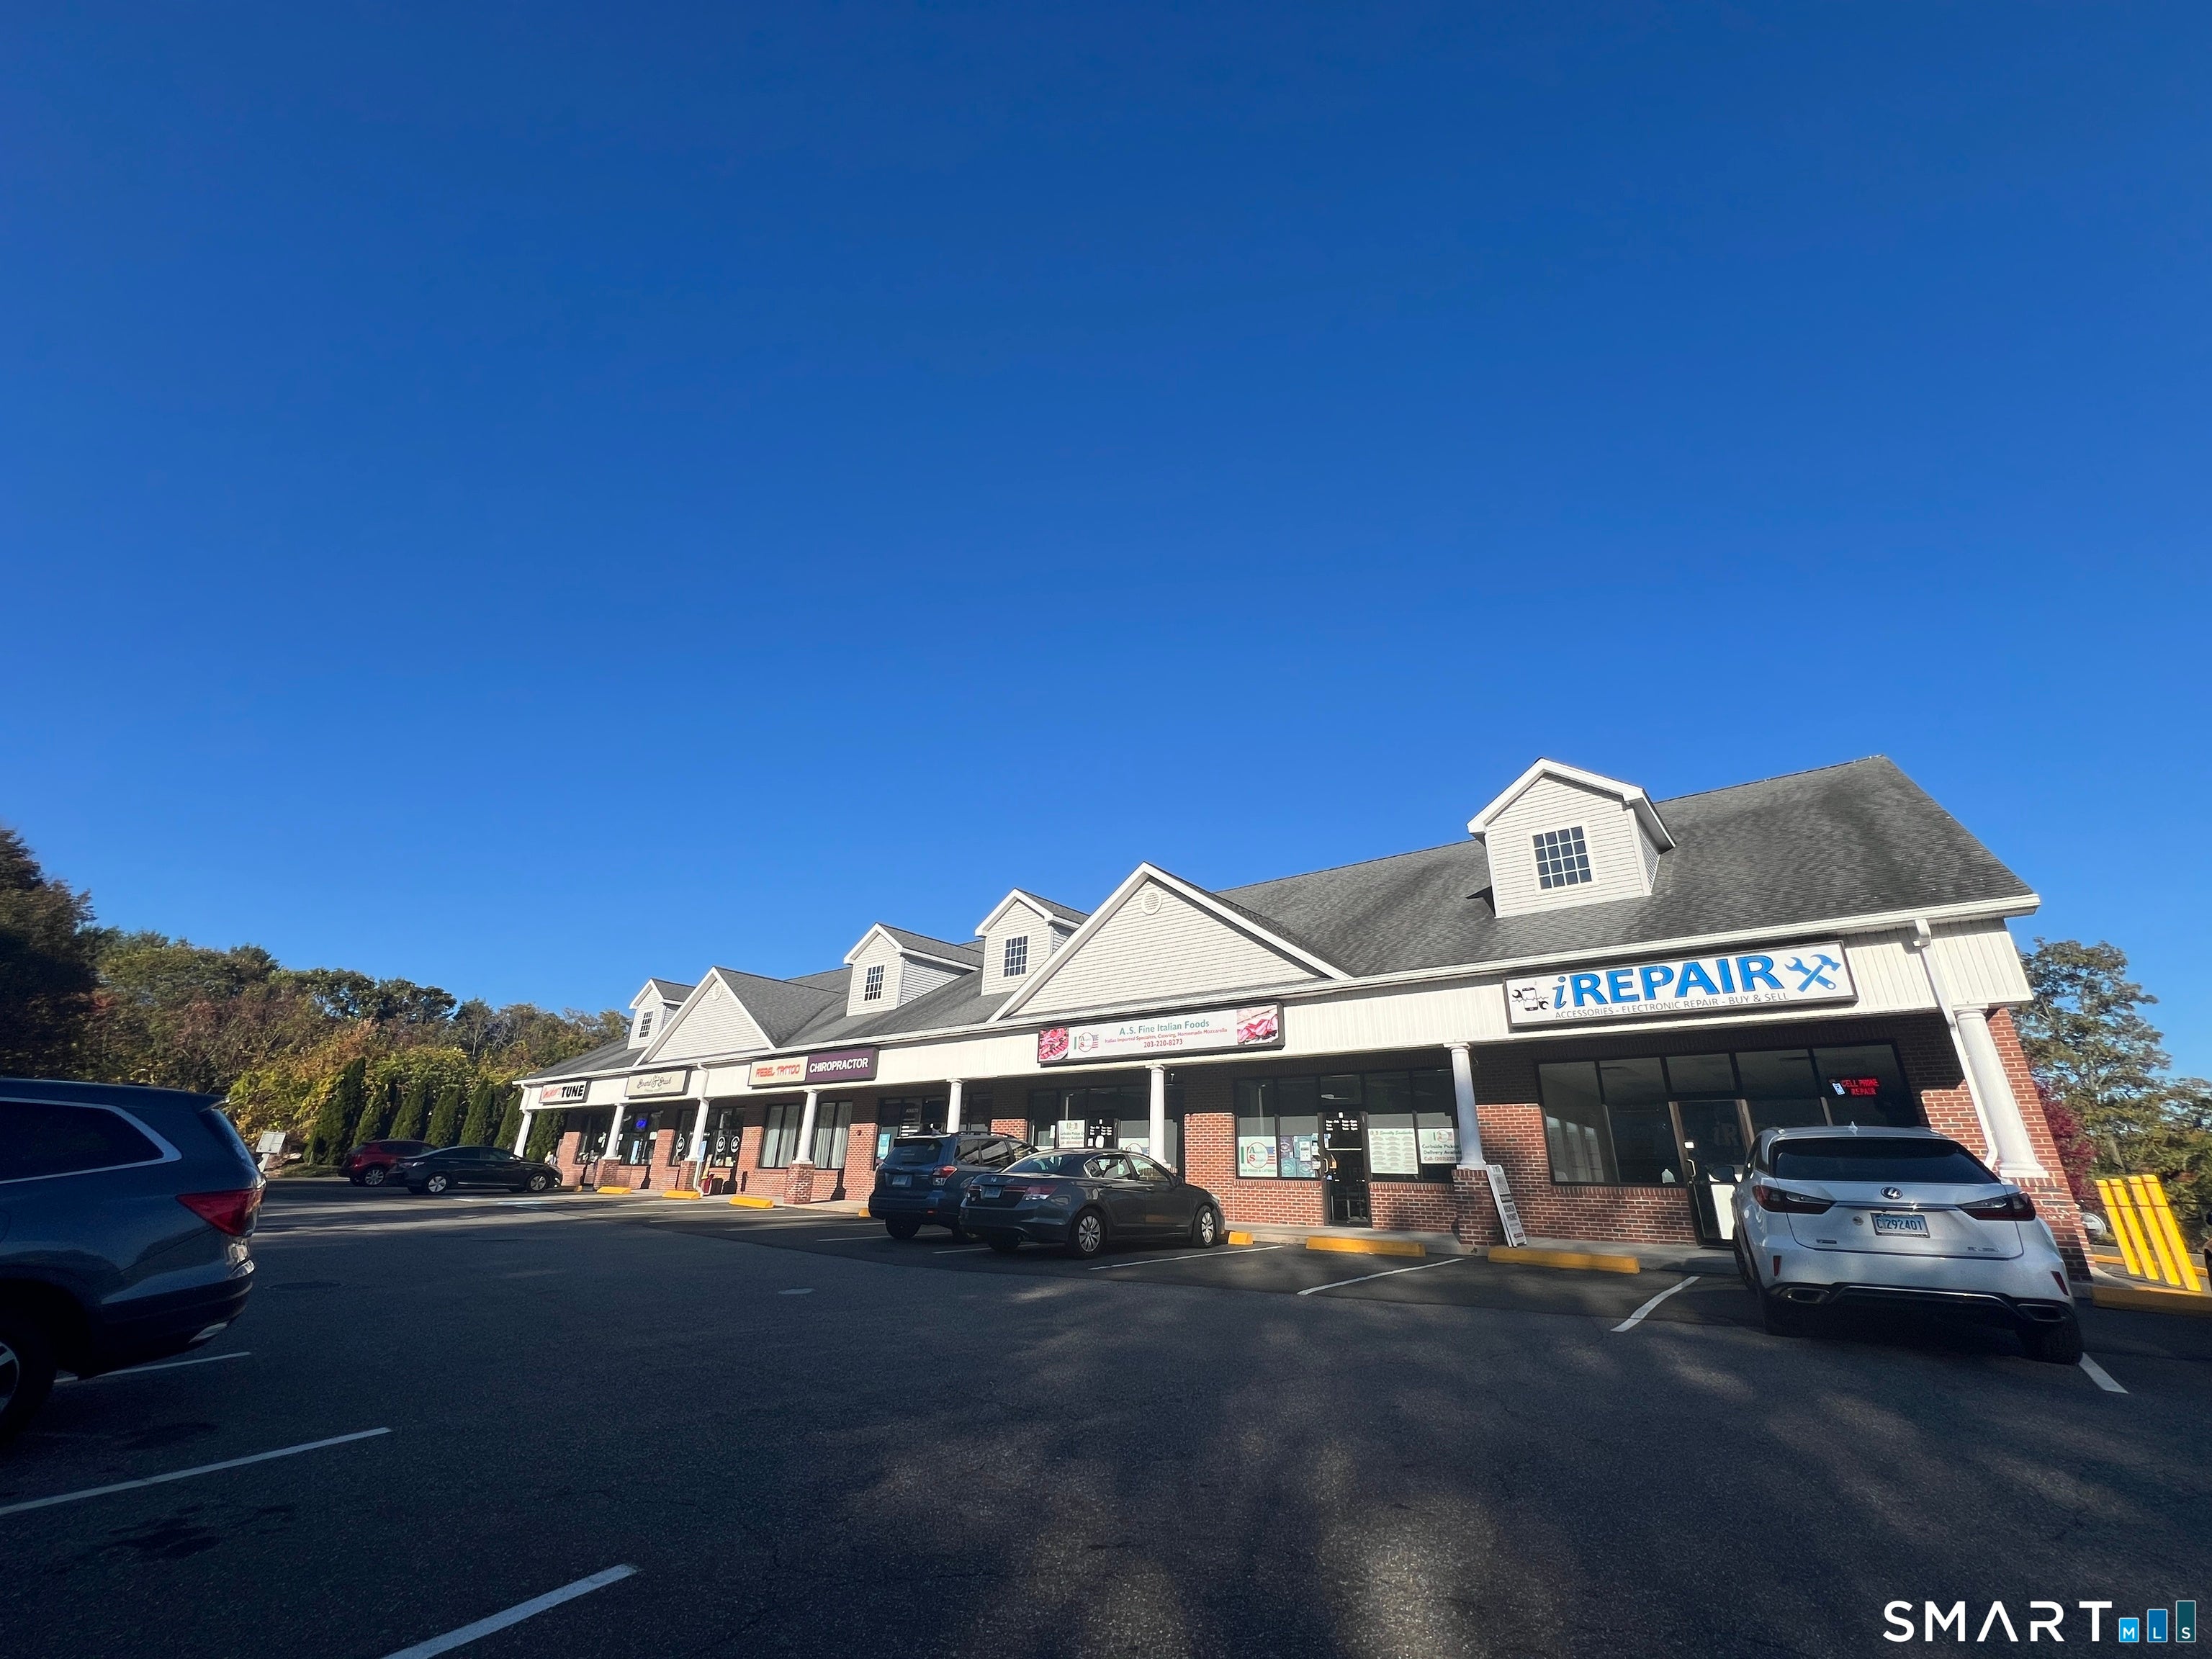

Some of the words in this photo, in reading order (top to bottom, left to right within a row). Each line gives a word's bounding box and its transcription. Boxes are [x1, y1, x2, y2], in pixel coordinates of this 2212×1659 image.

[1552, 955, 1785, 1010] iREPAIR
[1555, 1007, 1614, 1020] ACCESSORIES
[1622, 1000, 1681, 1014] ELECTRONIC
[1683, 998, 1719, 1008] REPAIR
[1729, 996, 1750, 1005] BUY
[1753, 994, 1763, 1003] &
[1764, 992, 1789, 1002] SELL
[1119, 1026, 1136, 1035] A.S.
[1138, 1025, 1155, 1034] Fine
[1157, 1022, 1182, 1032] Italian
[1184, 1019, 1210, 1029] Foods
[1143, 1038, 1183, 1048] 203-220-8273
[756, 1066, 775, 1077] REBEL
[776, 1064, 801, 1076] TATTOO
[809, 1057, 869, 1073] CHIROPRACTOR
[1858, 1078, 1879, 1087] PHONE
[562, 1084, 585, 1098] TUNE
